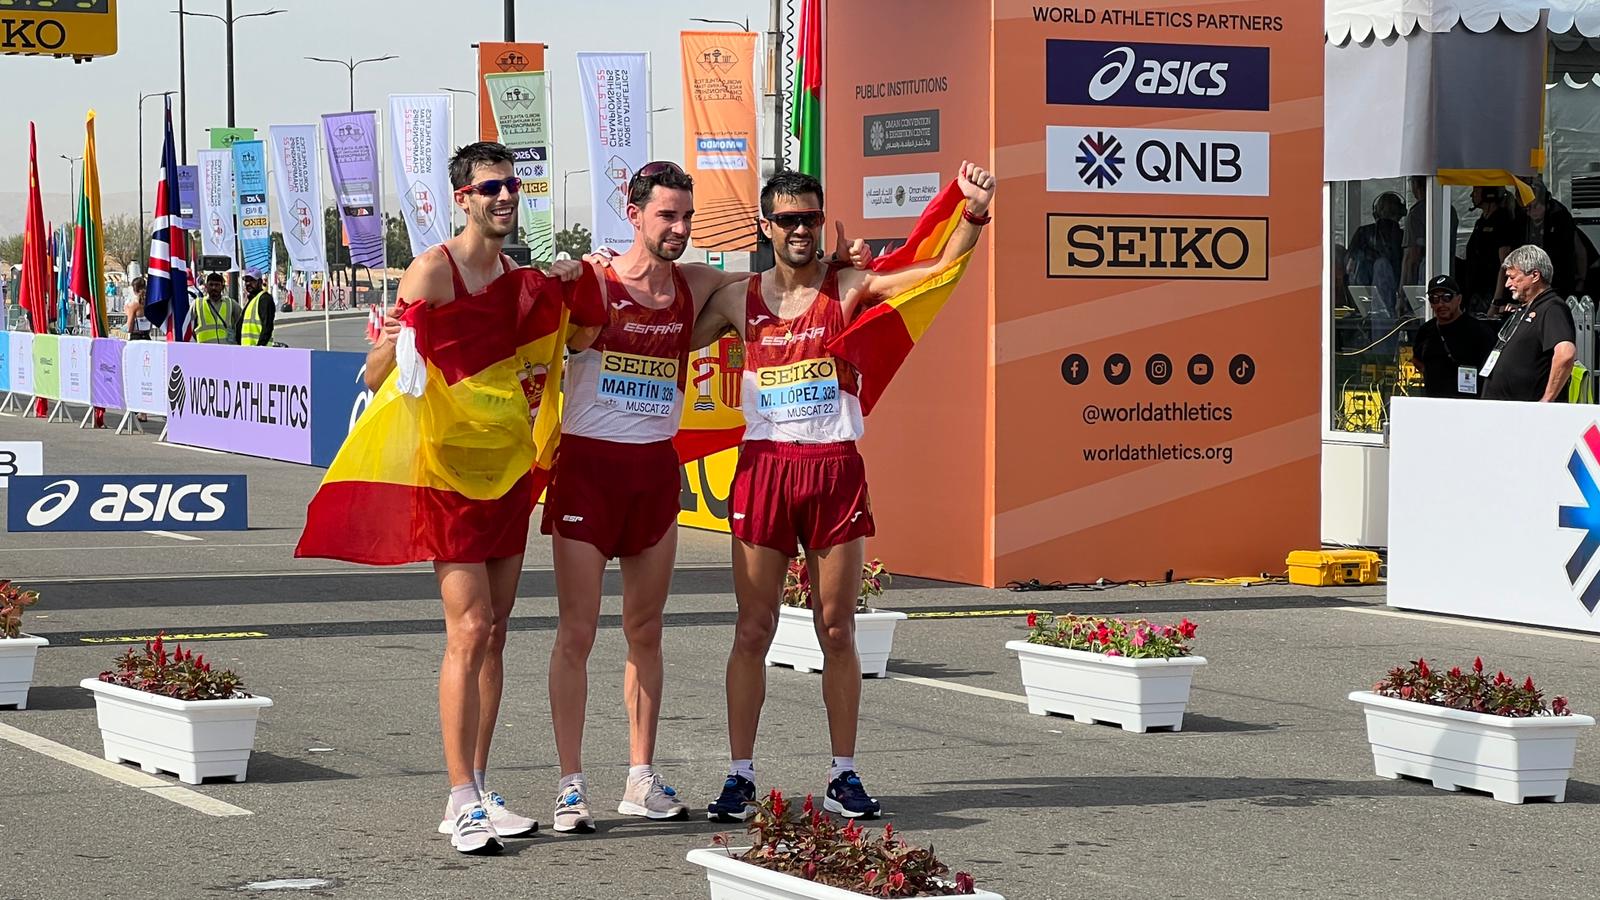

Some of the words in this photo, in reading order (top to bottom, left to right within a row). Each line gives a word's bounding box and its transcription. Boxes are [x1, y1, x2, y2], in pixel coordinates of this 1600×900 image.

[1033, 6, 1096, 24] WORLD
[1101, 10, 1192, 28] ATHLETICS
[1197, 13, 1283, 32] PARTNERS
[855, 83, 886, 100] PUBLIC
[887, 76, 948, 97] INSTITUTIONS
[1134, 58, 1229, 96] asics
[1135, 139, 1243, 184] QNB
[1067, 223, 1250, 270] SEIKO
[624, 322, 683, 334] ESPAÑA
[604, 355, 676, 378] SEIKO
[760, 362, 834, 386] SEIKO
[602, 378, 660, 399] MARTÍN
[662, 386, 674, 402] 326
[760, 394, 776, 407] M.
[781, 386, 820, 404] LÓPEZ
[822, 386, 836, 400] 325
[189, 376, 230, 420] WORLD
[233, 380, 308, 430] ATHLETICS
[626, 400, 660, 413] MUSCAT
[660, 404, 670, 414] 22
[787, 404, 822, 418] MUSCAT
[823, 403, 834, 414] 22
[1082, 402, 1233, 425] @worldathletics
[1082, 444, 1233, 464] worldathletics.org
[90, 483, 228, 522] asics
